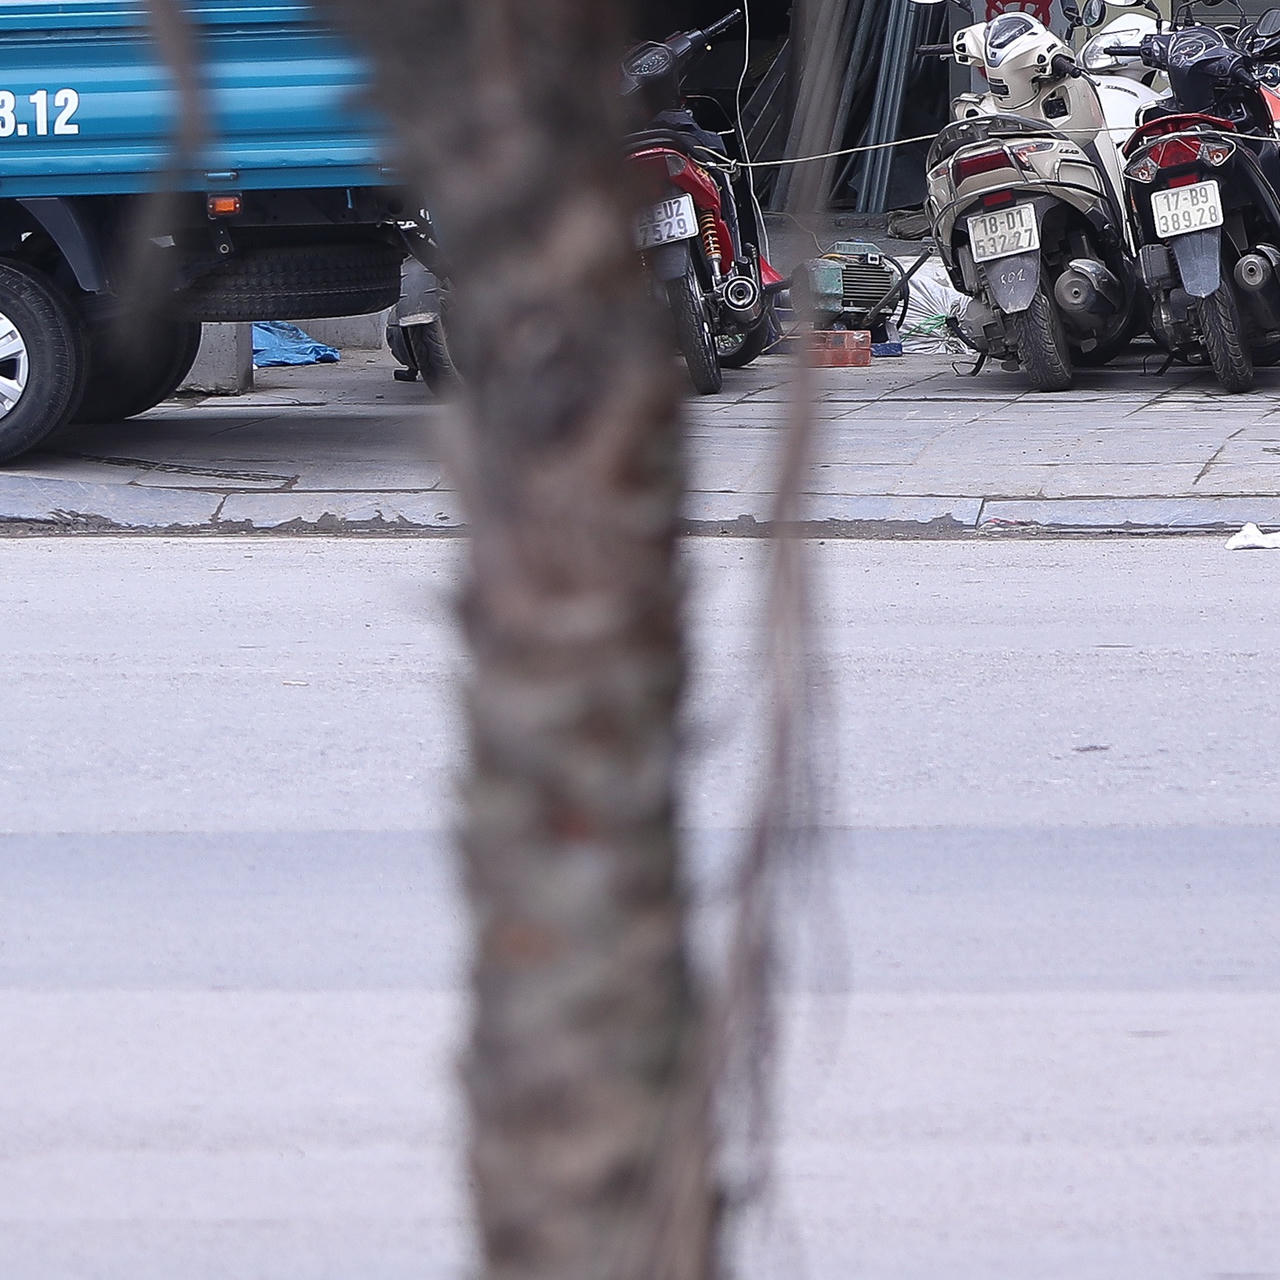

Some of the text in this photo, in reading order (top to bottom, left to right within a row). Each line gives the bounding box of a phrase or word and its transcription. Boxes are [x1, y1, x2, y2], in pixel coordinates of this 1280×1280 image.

[1163, 186, 1209, 212] 17-B9
[980, 208, 1025, 236] 18-D1
[1159, 205, 1218, 233] 389.28
